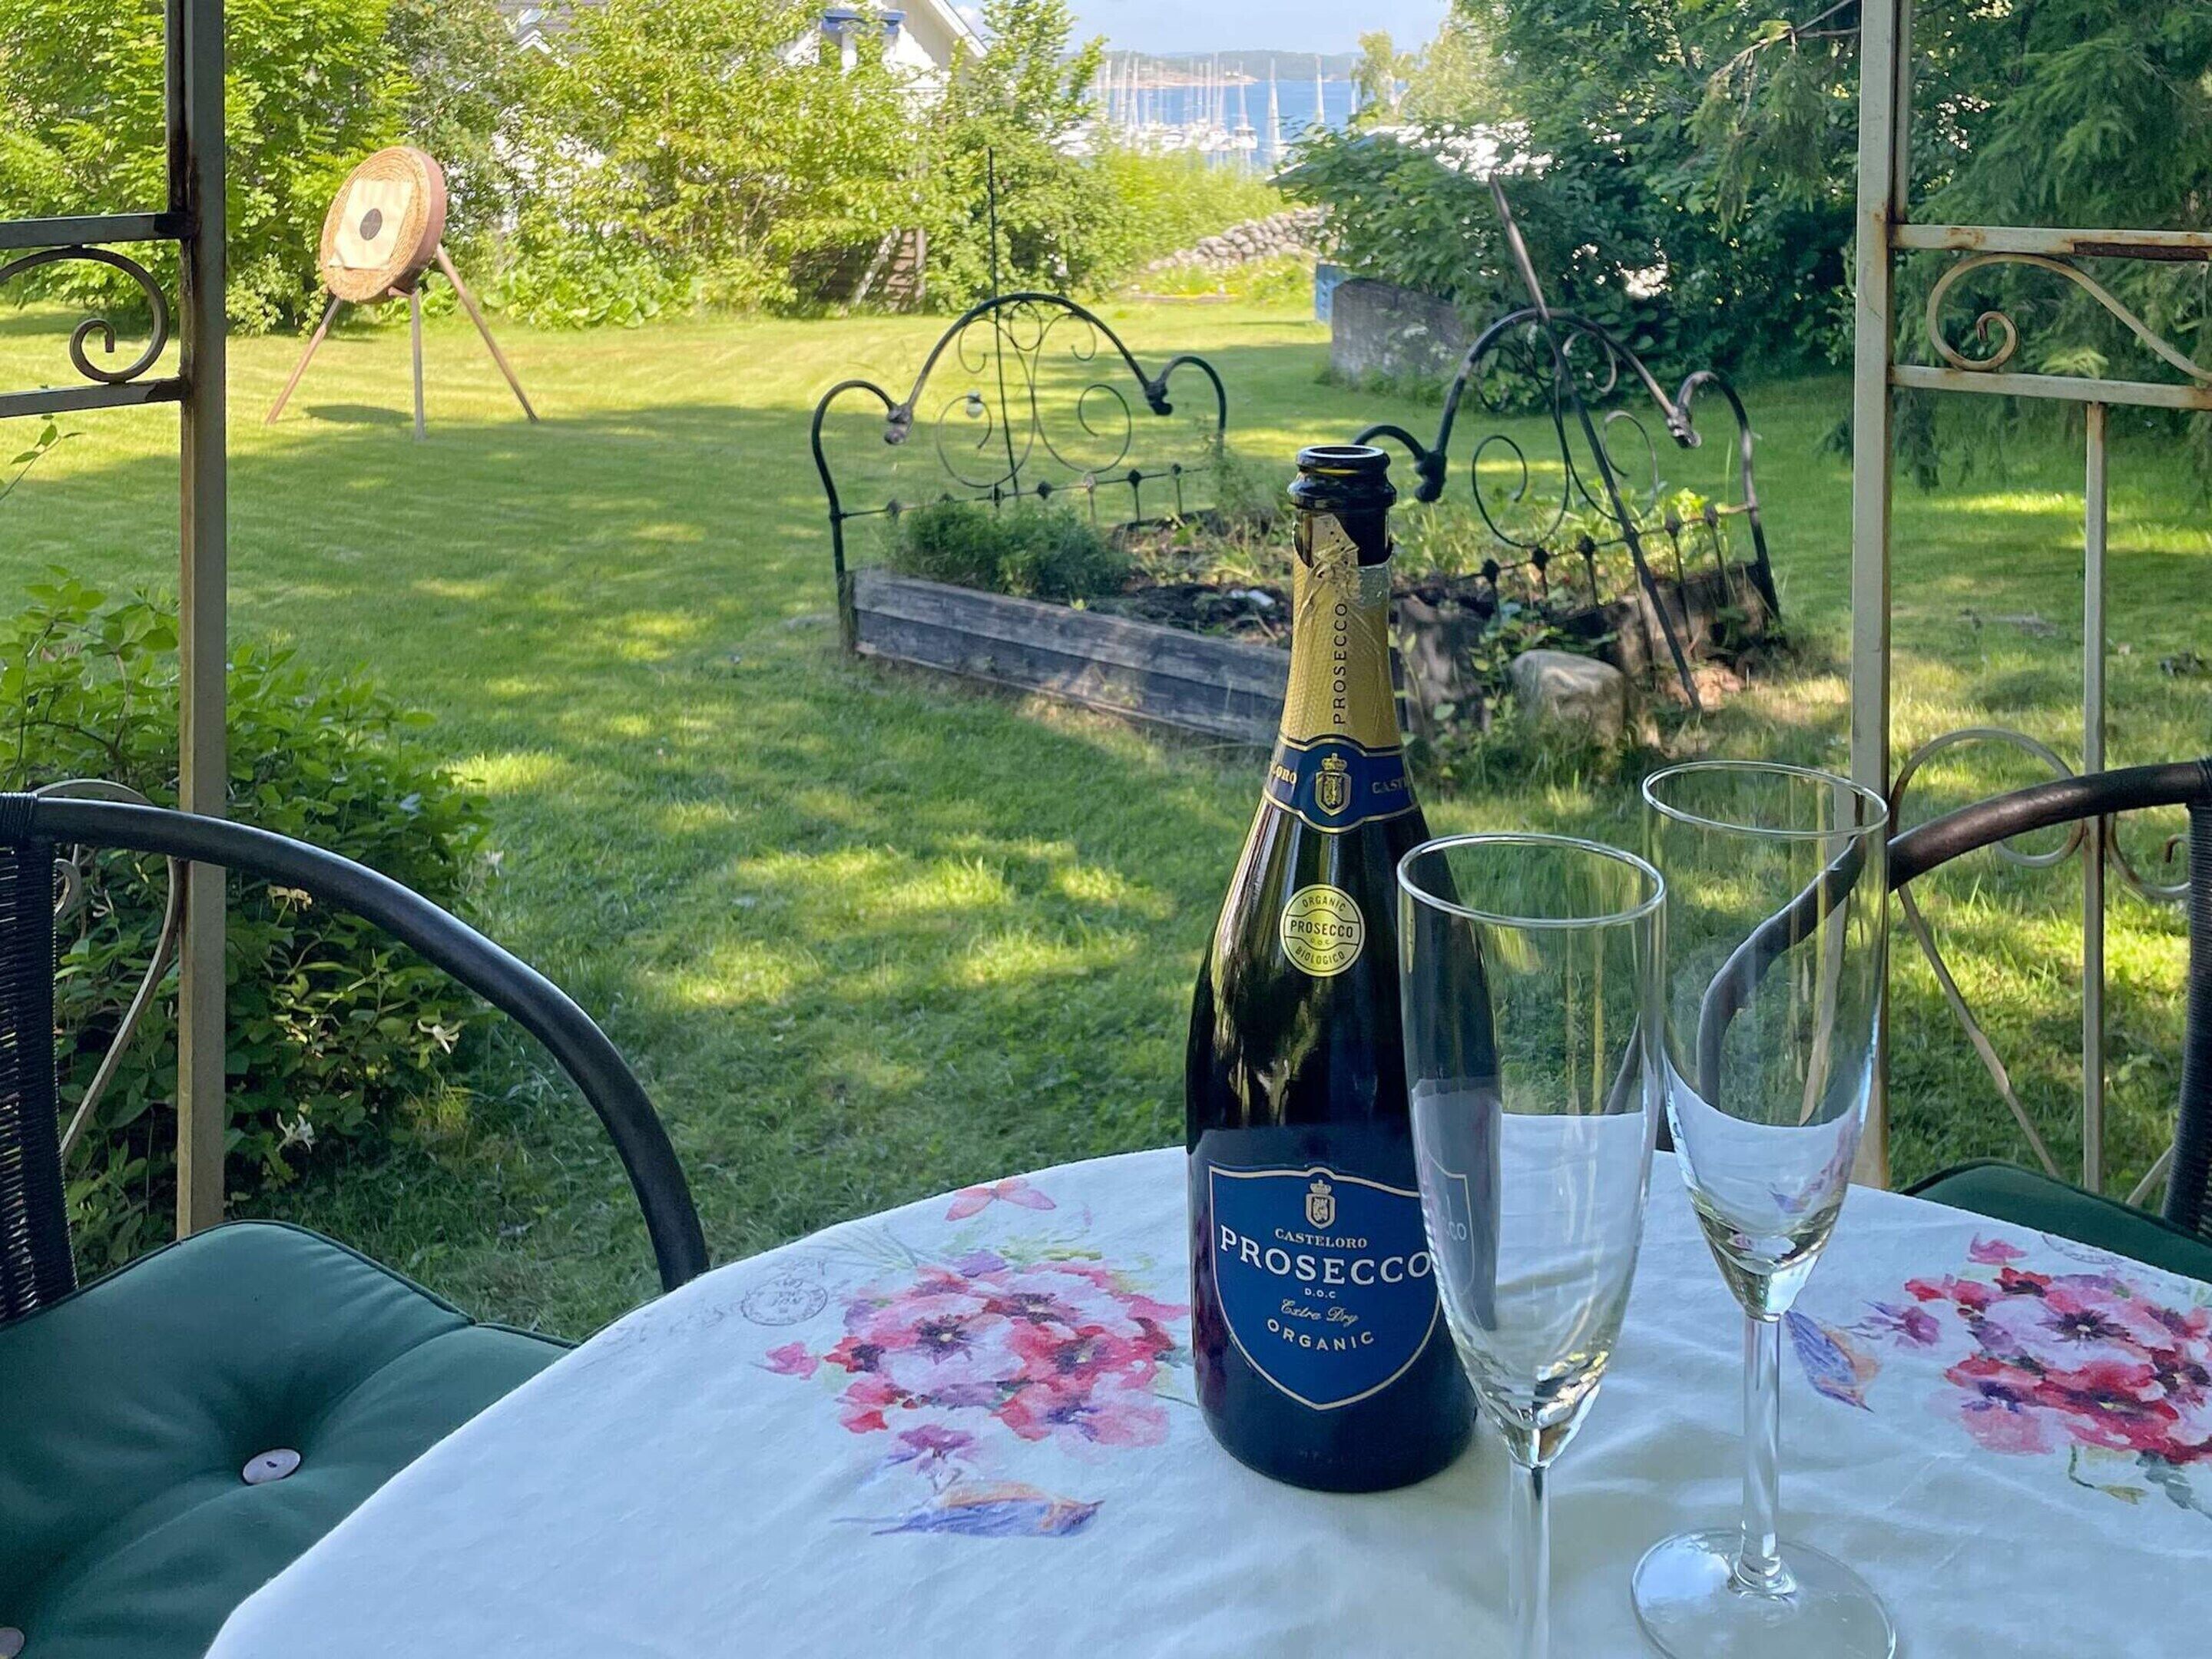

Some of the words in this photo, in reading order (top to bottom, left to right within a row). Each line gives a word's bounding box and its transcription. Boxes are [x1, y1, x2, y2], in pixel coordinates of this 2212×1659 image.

[1333, 603, 1347, 724] PROSECCO
[1302, 896, 1346, 912] ORGANIC
[1290, 920, 1353, 938] PROSECCO
[1295, 945, 1345, 965] BIOLOGICO
[1274, 1228, 1367, 1248] CASTELORO
[1220, 1224, 1432, 1285] PROSECCO
[1279, 1298, 1321, 1320] Extra
[1326, 1306, 1359, 1329] Dry
[1267, 1319, 1374, 1351] ORGANIC
